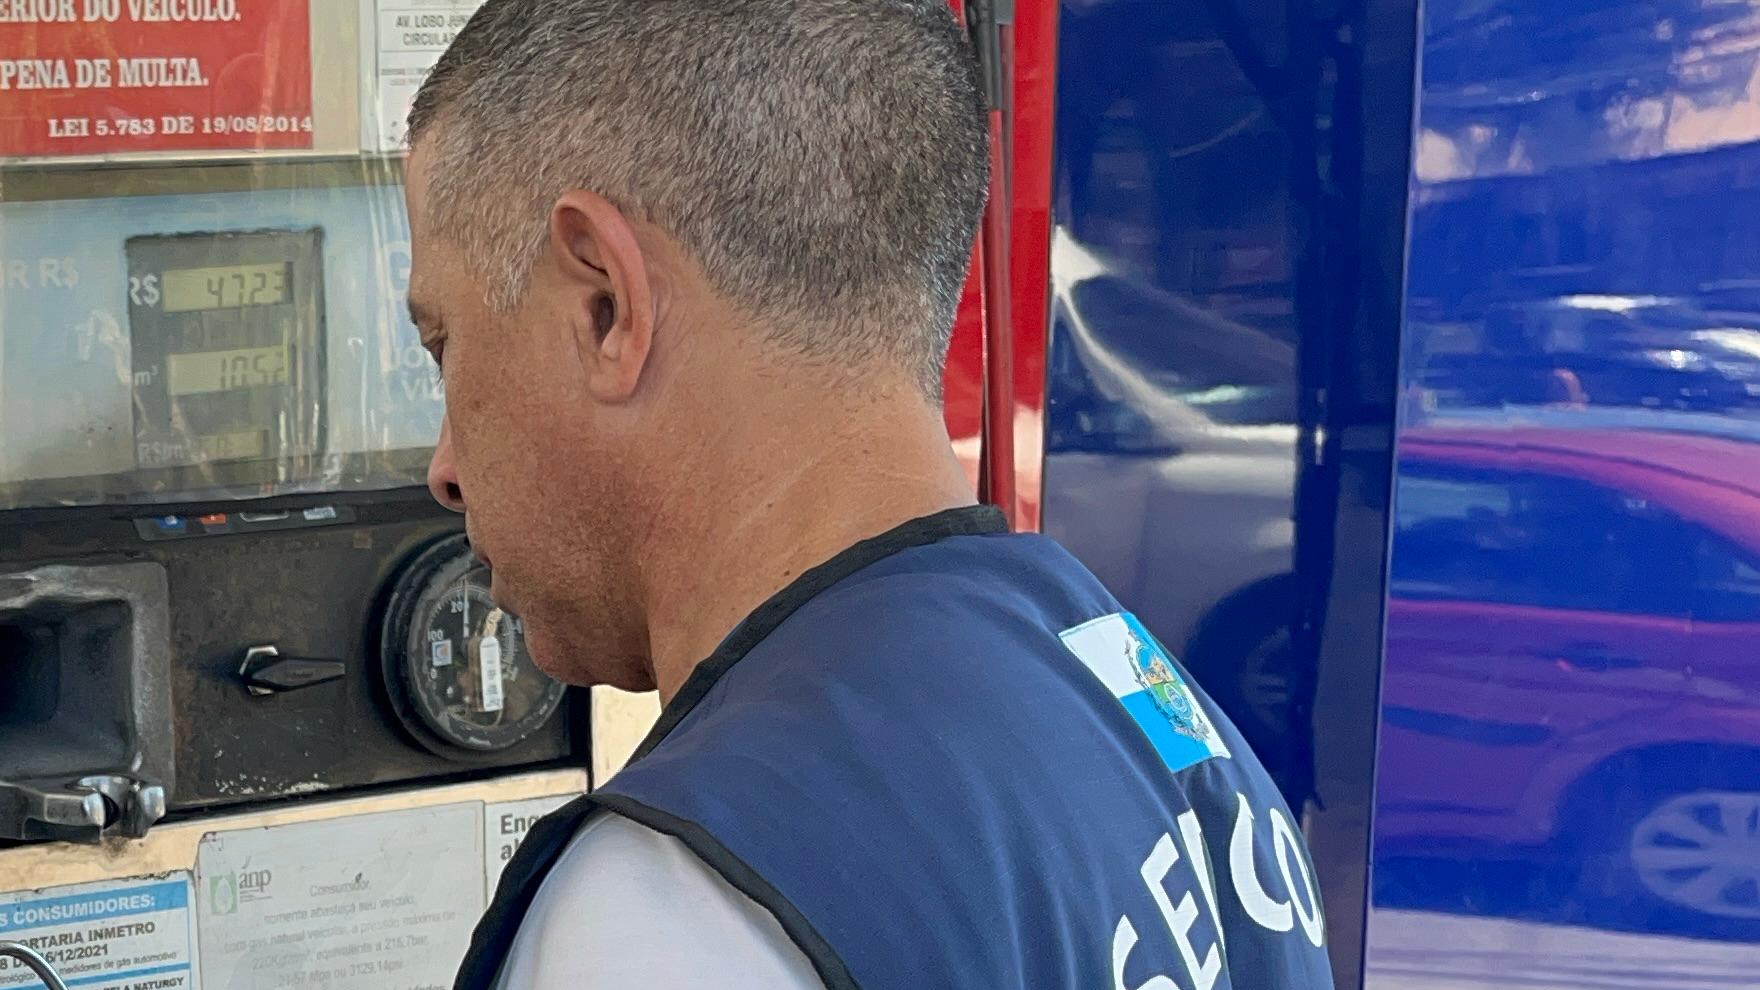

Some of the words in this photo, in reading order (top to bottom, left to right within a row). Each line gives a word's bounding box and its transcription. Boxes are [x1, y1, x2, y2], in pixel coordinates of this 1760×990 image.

[83, 0, 121, 22] DO
[0, 59, 64, 90] PENA
[75, 59, 112, 88] DE
[118, 57, 209, 88] MULTA.
[49, 118, 90, 138] LEI
[96, 118, 155, 137] 5.783
[161, 117, 195, 135] DE
[201, 115, 313, 134] 19/08/2014
[239, 869, 272, 893] anp
[13, 894, 156, 926] CONSUMIDORES:
[19, 929, 84, 950] ORTARIA
[87, 921, 156, 942] INMETRO
[40, 943, 109, 964] 6/12/2021
